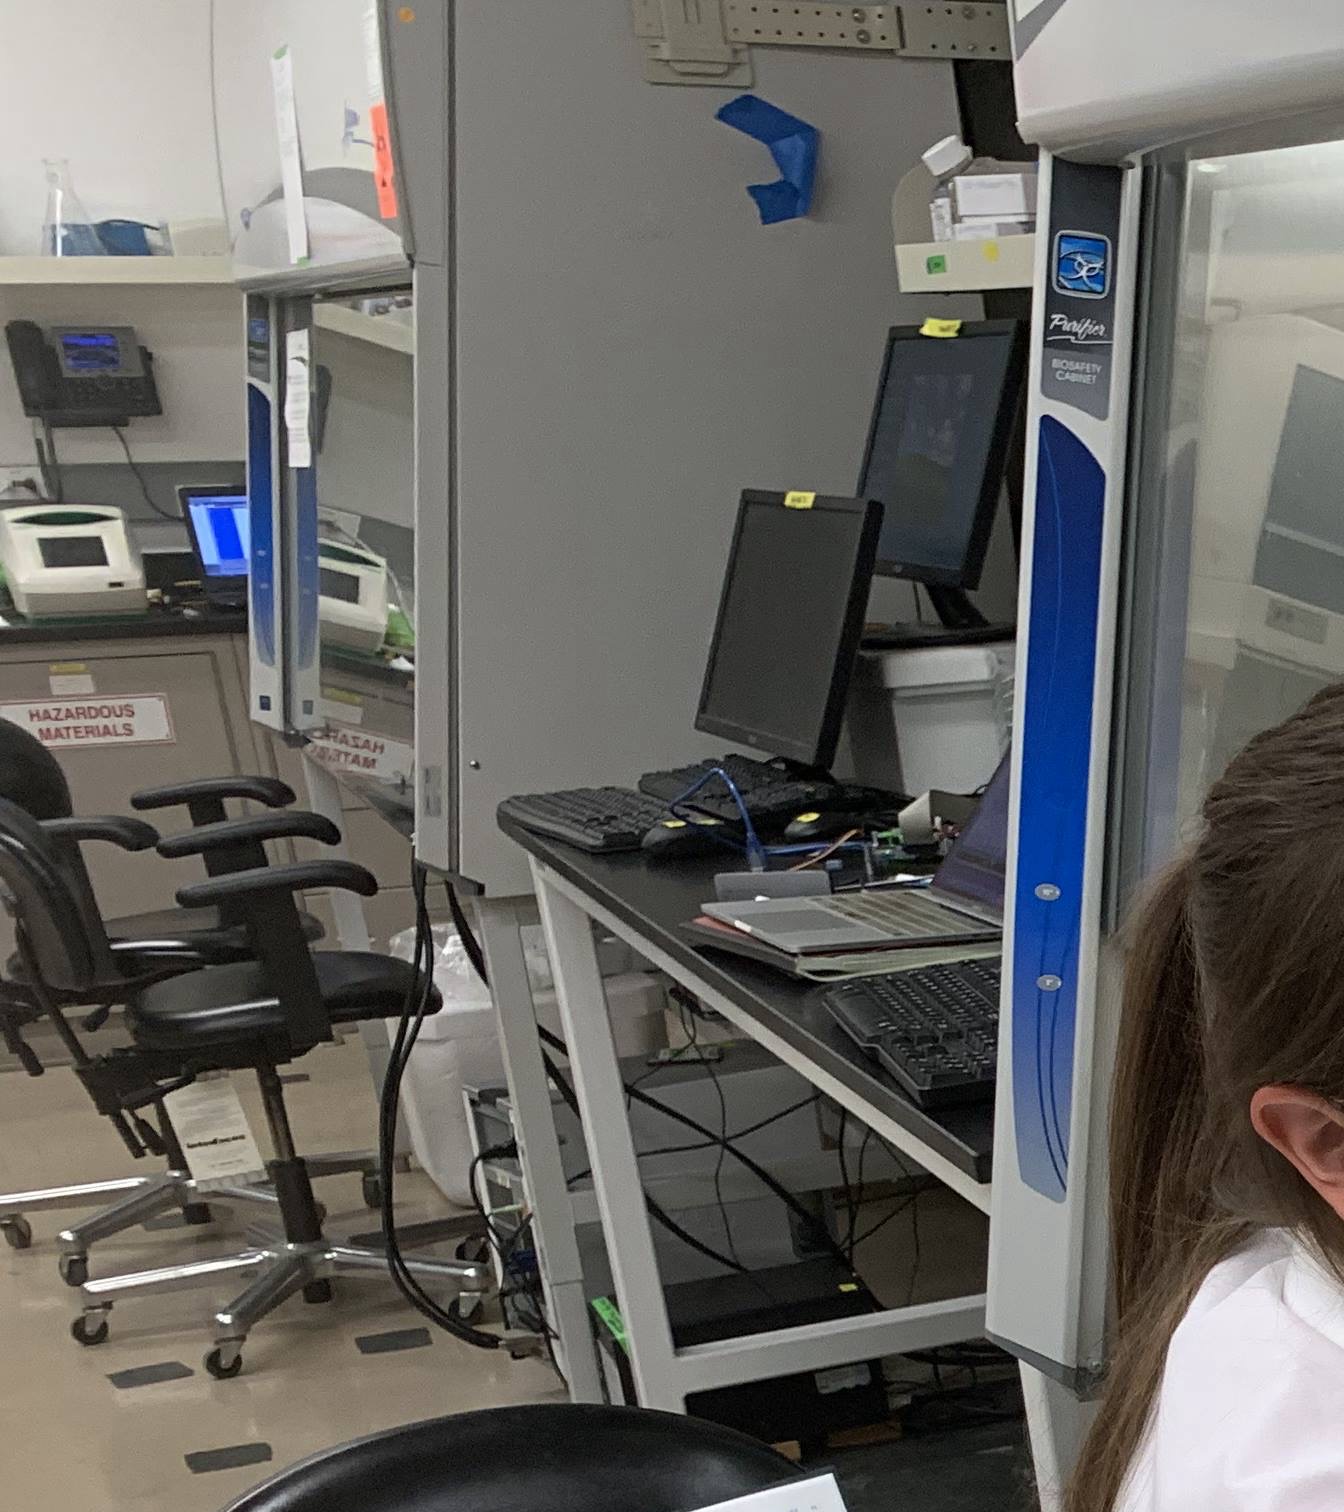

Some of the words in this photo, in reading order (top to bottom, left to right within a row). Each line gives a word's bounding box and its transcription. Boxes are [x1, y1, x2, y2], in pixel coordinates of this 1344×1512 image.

[1049, 314, 1106, 340] Purifier
[1051, 358, 1102, 374] BIOSAFETY
[1055, 370, 1097, 385] CABINET
[29, 704, 135, 722] HAZARDOUS
[38, 723, 134, 741] MATERIALS
